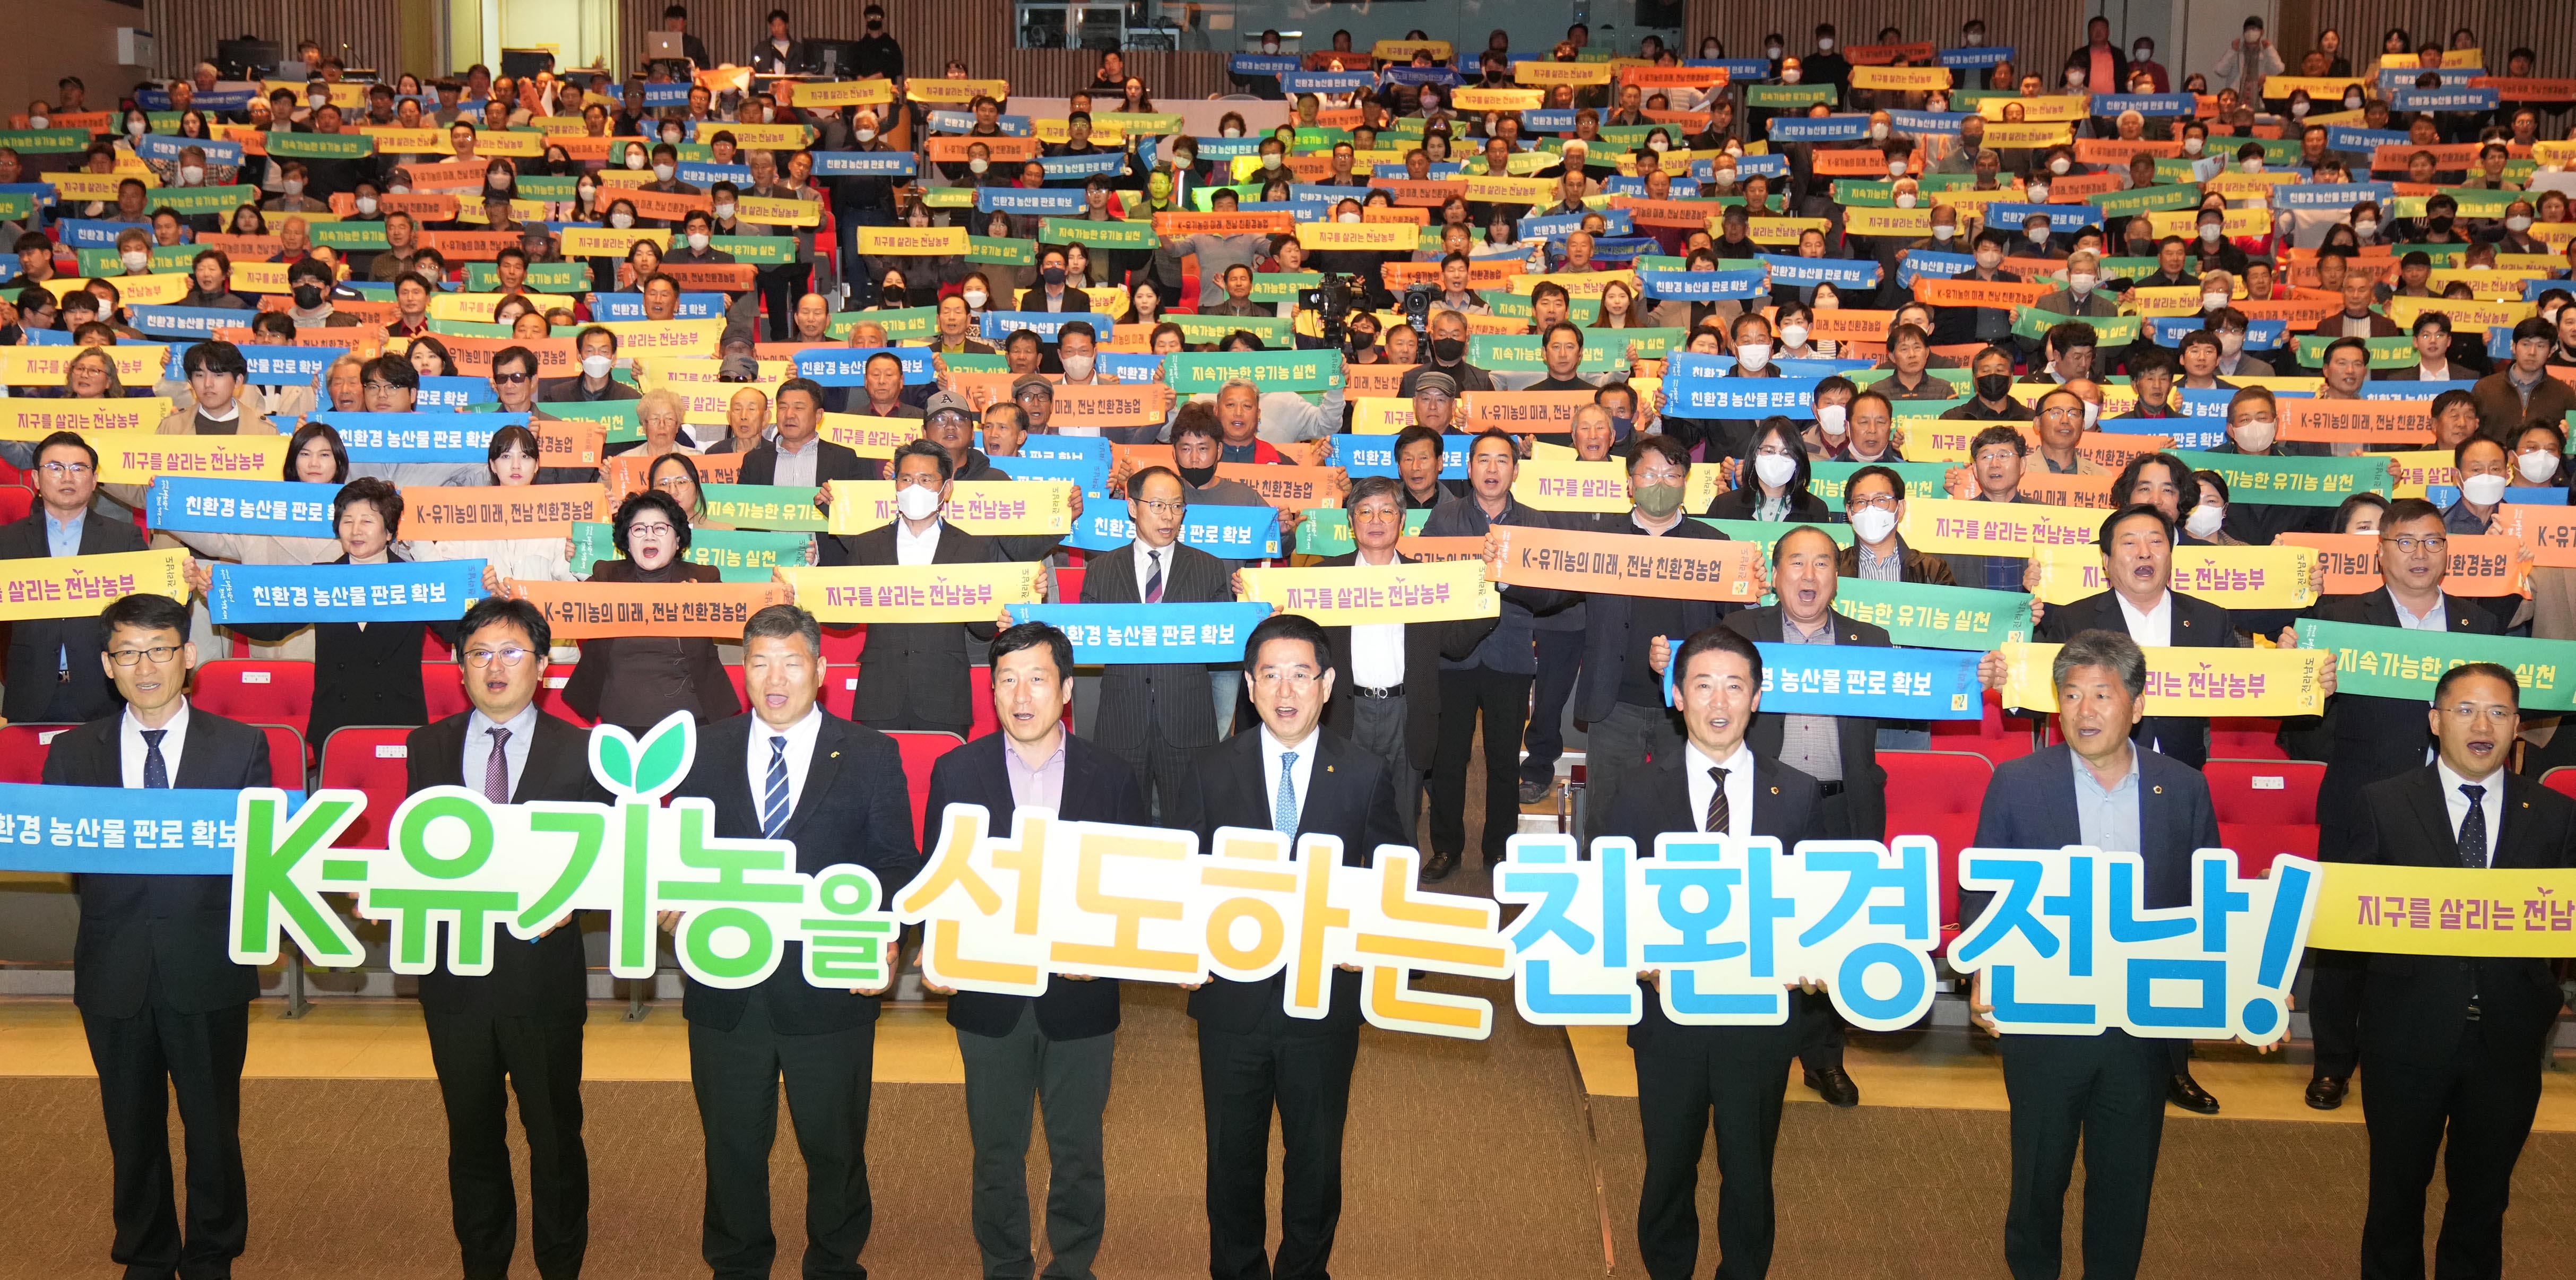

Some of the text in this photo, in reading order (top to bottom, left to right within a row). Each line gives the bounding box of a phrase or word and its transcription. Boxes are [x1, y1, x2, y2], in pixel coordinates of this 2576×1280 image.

[827, 160, 847, 168] 친환경
[871, 160, 884, 169] 판로
[886, 160, 899, 169] 확보
[1466, 183, 1535, 196] 지구를 살리는 전남농부
[195, 196, 218, 206] 유기농
[218, 195, 236, 205] 실천
[875, 237, 948, 247] 지구를 살리는 전남농부
[1059, 228, 1140, 240] 지속가능한 유기농 실천
[1320, 232, 1394, 242] 지구를 살리는 전남농부
[1770, 265, 1860, 281] 친환경 농산물 판로 확보
[1656, 281, 1747, 292] 친환경 농산물 판로 확보
[1938, 289, 2033, 305] K-유기농의 미래, 전남 친환경농업
[1192, 365, 1316, 383] 지속가능한 유기농 실천
[940, 393, 954, 404] A
[1055, 399, 1140, 416] 미래, 전남 친환경농업
[1692, 392, 1795, 407] 친환경 농산물 판로
[18, 413, 139, 429] 지구를 살리는 전남농부
[1482, 405, 1570, 421] K-유기농의 미래, 전남
[2302, 413, 2395, 431] K-유기농의 미래, 전남
[340, 430, 493, 448] 친환경 농산물 판로 확보
[123, 452, 264, 471] 지구를 살리는 전남농부
[1261, 480, 1312, 500] 친환경농업
[1539, 478, 1621, 497] 지구를 살리는
[2274, 473, 2353, 491] 유기농 실천
[186, 496, 322, 521] 친환경 농산물 판로
[417, 501, 594, 525] K-유기농의 미래, 전남 친환경농업
[706, 501, 779, 521] 지속가능한
[969, 500, 1025, 519] 전남농부
[1190, 525, 1218, 543] 판로
[1223, 526, 1251, 543] 확보
[1937, 518, 2092, 544] 지구를 살리는 전남농부
[695, 548, 777, 569] 유기농 실천
[1523, 548, 1721, 582] K-유기농의 미래, 전남 친환경농업
[1738, 549, 1749, 580] 전라남도
[166, 557, 175, 586] 전라남도
[2196, 569, 2264, 590] 전남농부
[2297, 555, 2306, 585] 전라남도
[8, 574, 136, 602] 살리는 전남농부
[1479, 566, 1487, 595] 전라남도
[253, 583, 446, 606] 친환경 농산물 판로 확보
[826, 585, 991, 606] 지구를 살리는 전남농부
[1287, 583, 1449, 609] 지구를 살리는 전남농부
[544, 602, 748, 624] K-유기농의 미래, 전남 친환경농업
[1837, 600, 1990, 632] 가능한 유기농 실천
[1061, 624, 1234, 646] 환경 농산물 판로 확보
[2302, 658, 2314, 693] 전라남도
[2336, 648, 2555, 689] 지속가능한 실천
[1781, 668, 1931, 696] 농산물 판로 확보
[2146, 671, 2264, 698] 리는 전남농부
[0, 814, 236, 851] 환경 농산물 판로 확보
[239, 795, 2312, 1035] K-유기농을 선도하는 친환경 전남!
[2358, 896, 2575, 931] 지구를 살리는 전남
